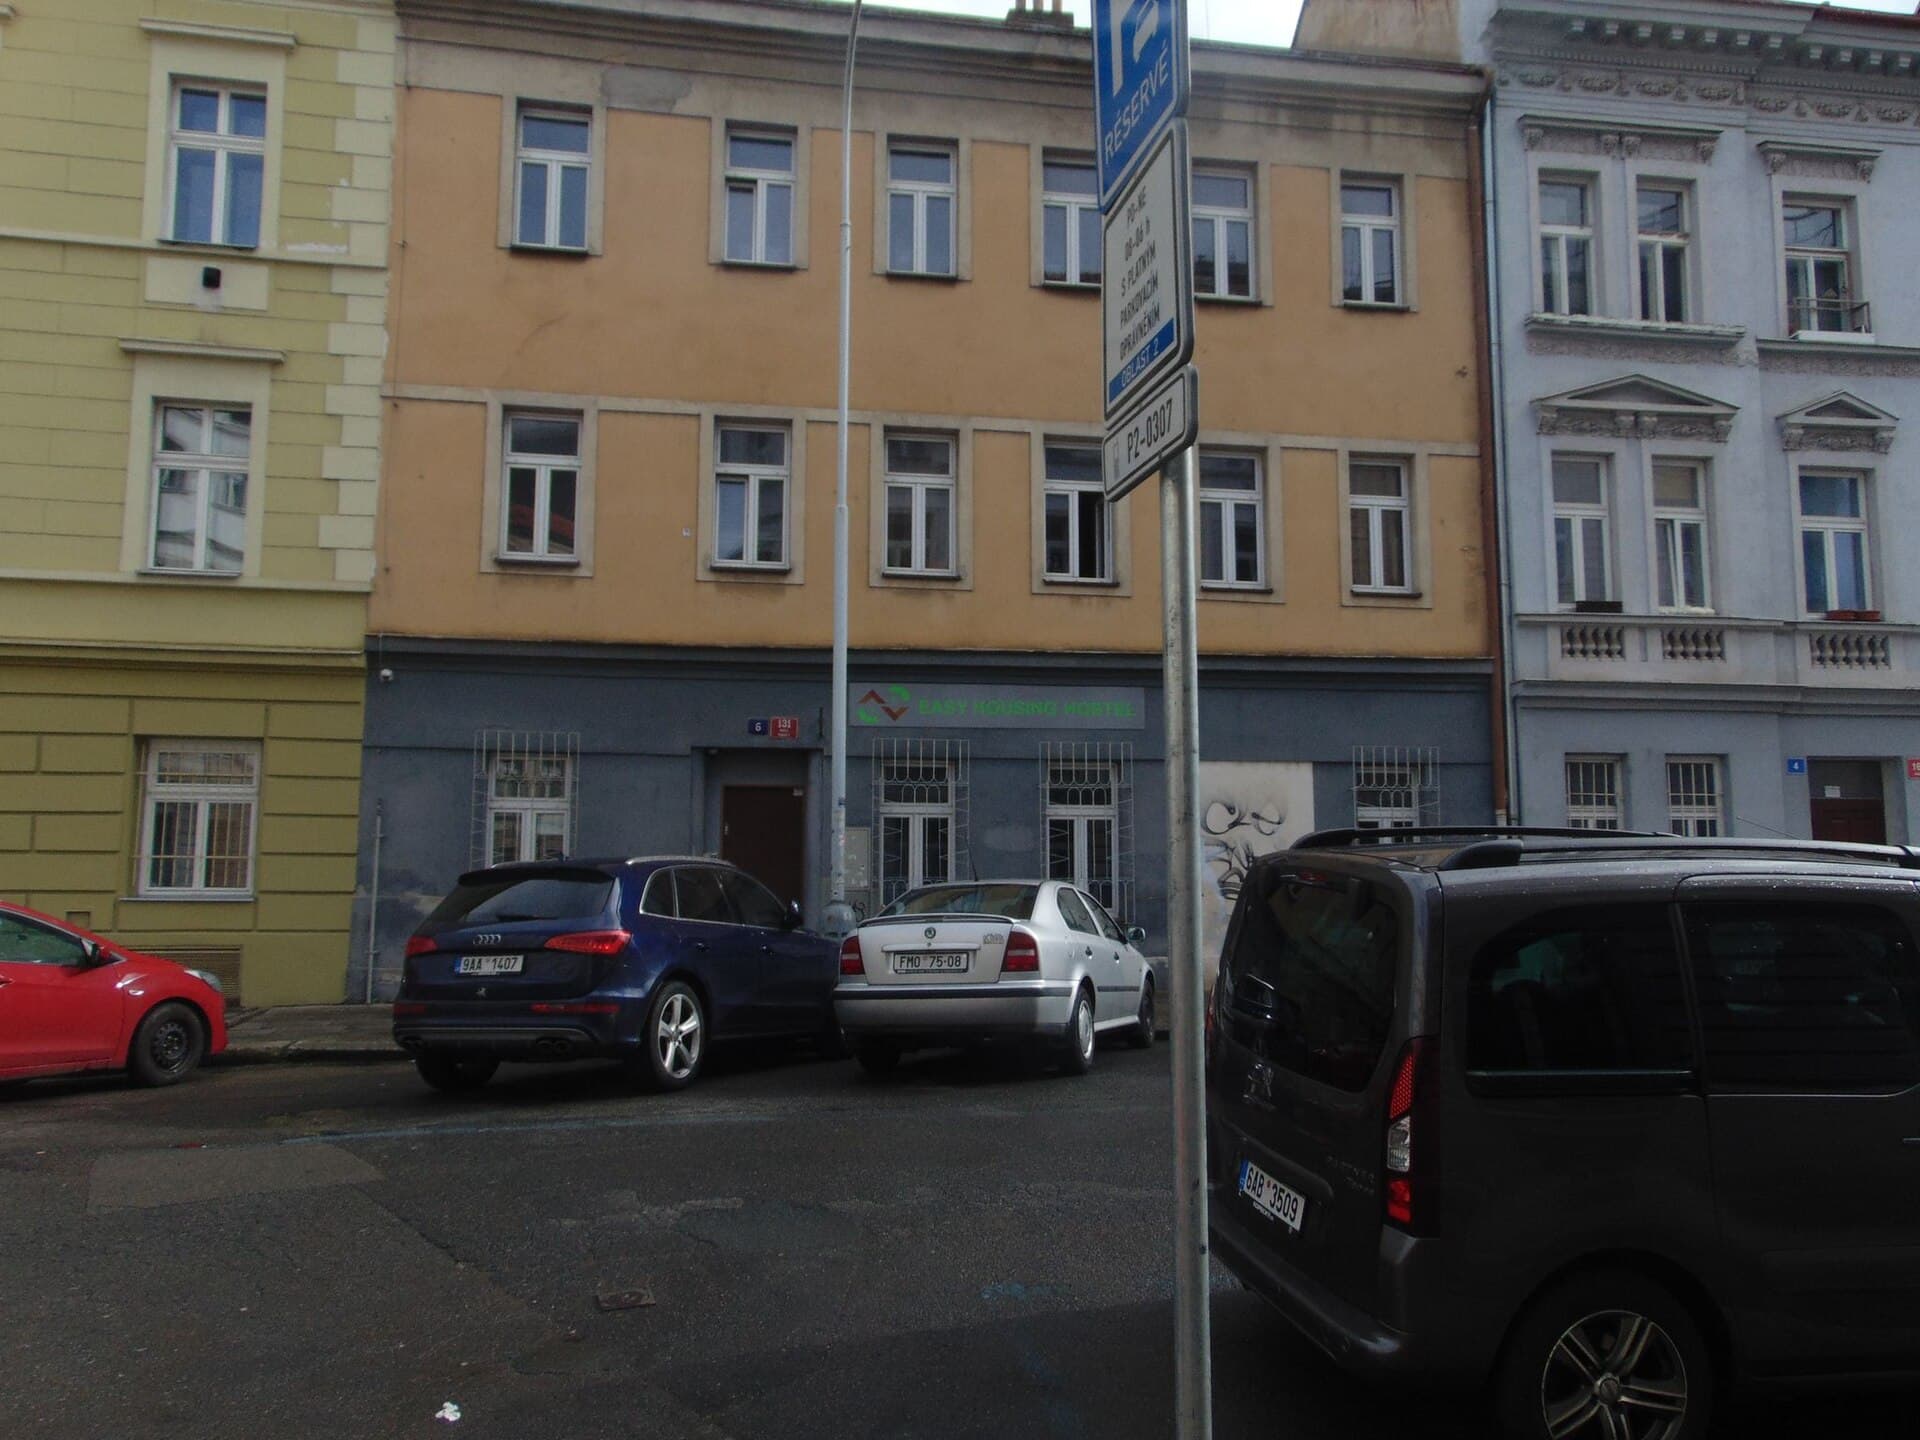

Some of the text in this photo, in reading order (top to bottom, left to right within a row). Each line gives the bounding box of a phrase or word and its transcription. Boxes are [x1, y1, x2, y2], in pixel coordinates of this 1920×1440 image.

[1121, 277, 1126, 297] S
[1121, 337, 1159, 388] OBLAST 2
[1127, 397, 1173, 465] P2-0307
[918, 698, 1136, 718] EASY HOUSING HOSTEL
[755, 722, 762, 732] 6
[1793, 761, 1799, 770] 4
[463, 957, 519, 971] 9AA 1407
[1246, 1166, 1264, 1198] 6AB
[1269, 1183, 1298, 1222] 3509
